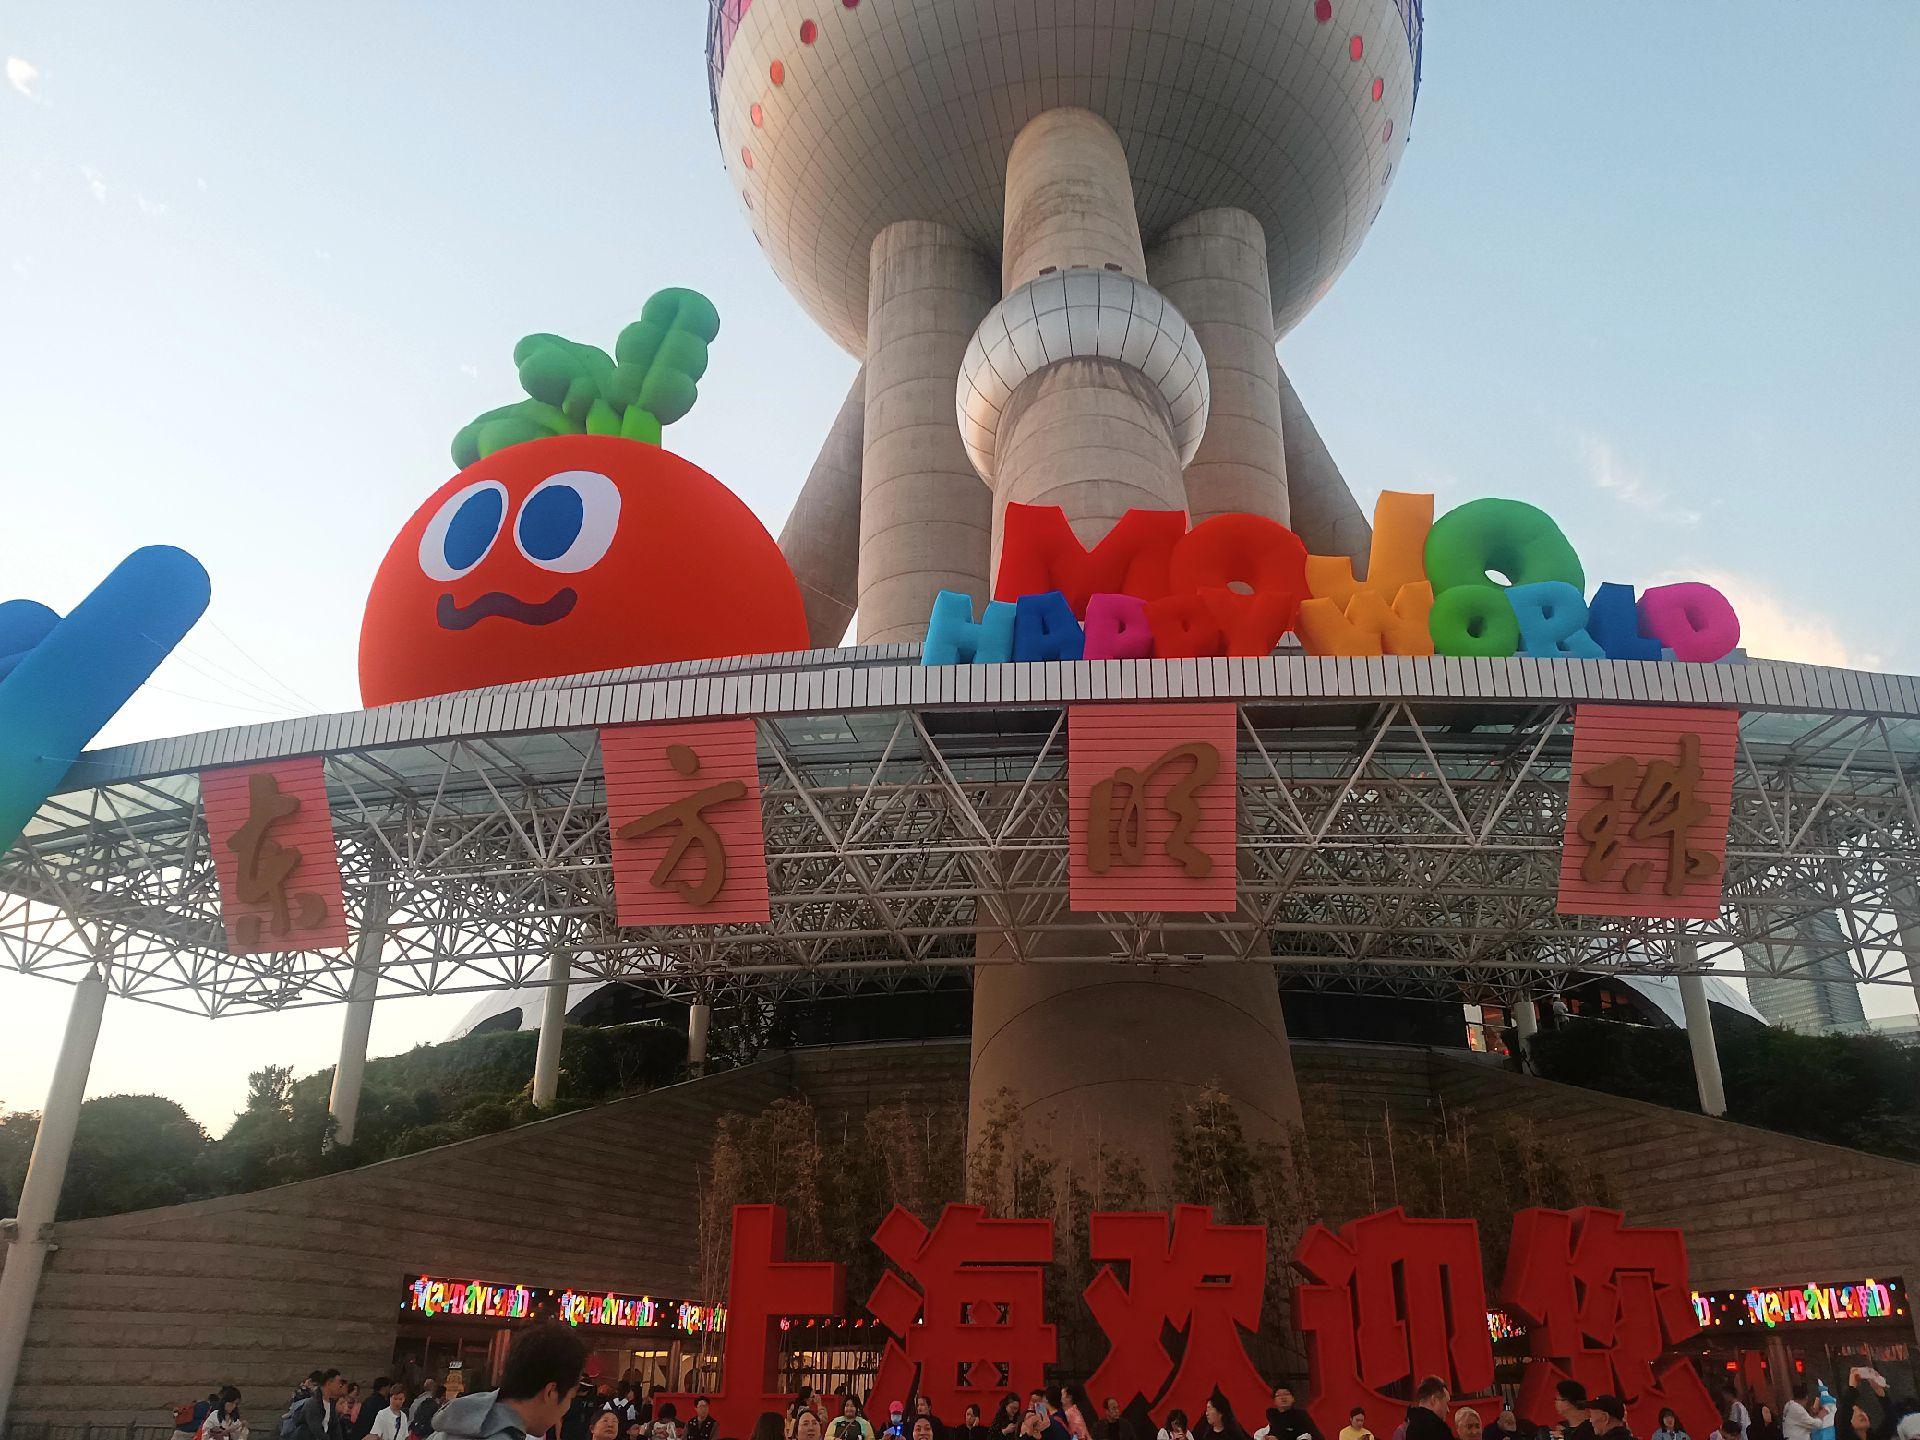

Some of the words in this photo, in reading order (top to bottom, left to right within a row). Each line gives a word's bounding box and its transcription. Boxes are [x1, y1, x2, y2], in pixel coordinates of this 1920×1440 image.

[994, 490, 1585, 622] MOJO
[922, 588, 1294, 665] HAPPY
[1298, 580, 1741, 664] WORLD
[653, 1202, 1723, 1436] 上海欢迎您
